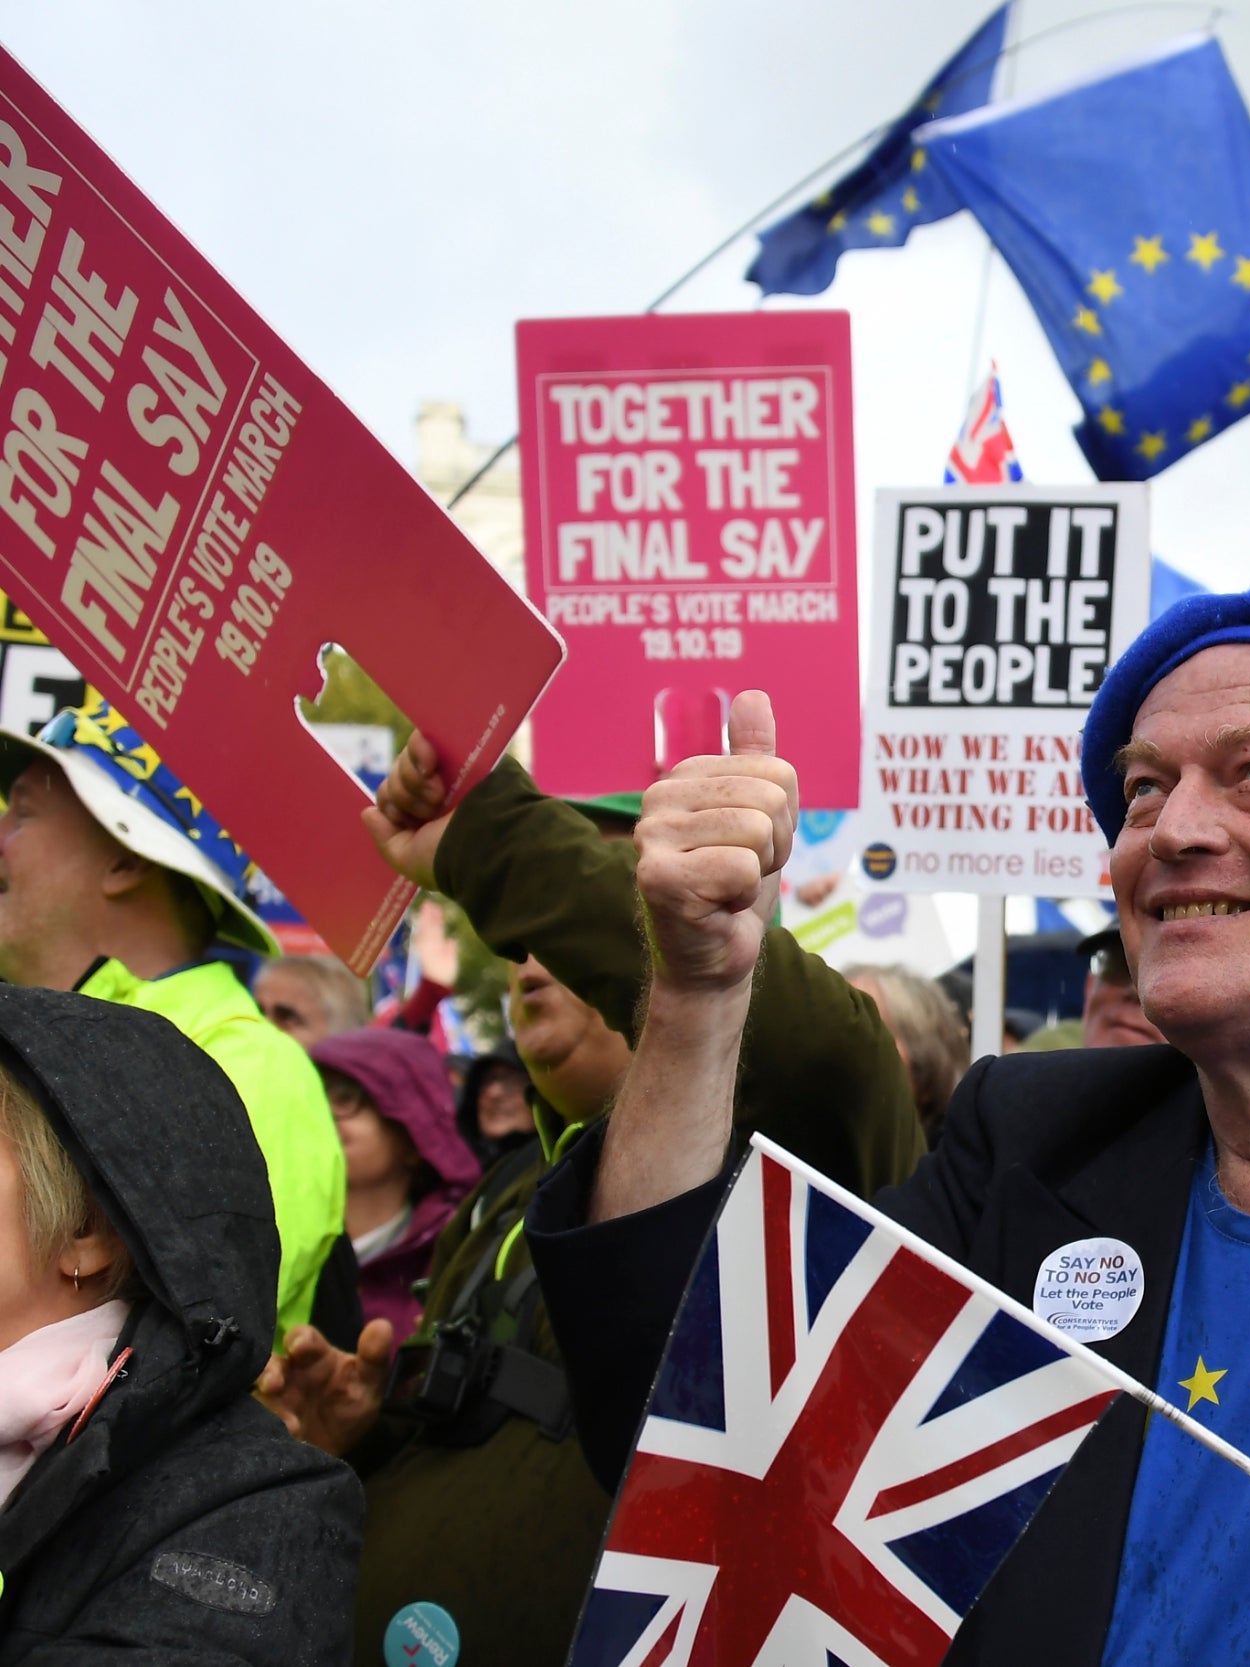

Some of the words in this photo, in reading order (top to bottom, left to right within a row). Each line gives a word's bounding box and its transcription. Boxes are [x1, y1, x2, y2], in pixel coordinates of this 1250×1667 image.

[30, 227, 139, 413] THE
[550, 378, 819, 444] TOGETHER
[0, 388, 89, 560] FOR
[61, 459, 180, 664] FINAL
[127, 286, 227, 476] SAY
[576, 450, 683, 513] FOR
[696, 449, 801, 510] THE
[135, 577, 214, 730] PEOPLE'S
[189, 490, 251, 592] VOTE
[222, 372, 303, 514] MARCH
[558, 519, 708, 581] FINAL
[720, 518, 824, 579] SAY
[901, 506, 1027, 577] PUT
[1047, 507, 1114, 577] IT
[215, 542, 293, 676] 19.10.19
[549, 594, 670, 625] PEOPLE'S
[676, 593, 742, 624] VOTE
[749, 591, 837, 622] MARCH
[899, 578, 969, 643] TO
[987, 578, 1109, 644] THE
[641, 628, 743, 660] 19.10.19
[894, 643, 1106, 704] PEOPLE
[876, 733, 947, 761] NOW
[961, 734, 1010, 761] WE
[879, 768, 974, 795] WHAT
[987, 769, 1037, 796] WE
[891, 802, 1012, 832] VOTING
[1027, 805, 1095, 833] FOR
[904, 851, 940, 873] no
[950, 852, 1024, 876] more
[1033, 847, 1084, 878] lies
[1045, 1269, 1069, 1283] TO
[1074, 1271, 1101, 1284] NO
[1105, 1267, 1138, 1284] SAY
[1059, 1256, 1096, 1269] SAY
[1099, 1255, 1124, 1269] NO
[1040, 1287, 1062, 1299] Let
[1066, 1288, 1089, 1299] the
[1092, 1287, 1137, 1301] People
[1072, 1300, 1104, 1310] Vote
[403, 1615, 450, 1666] Renew
